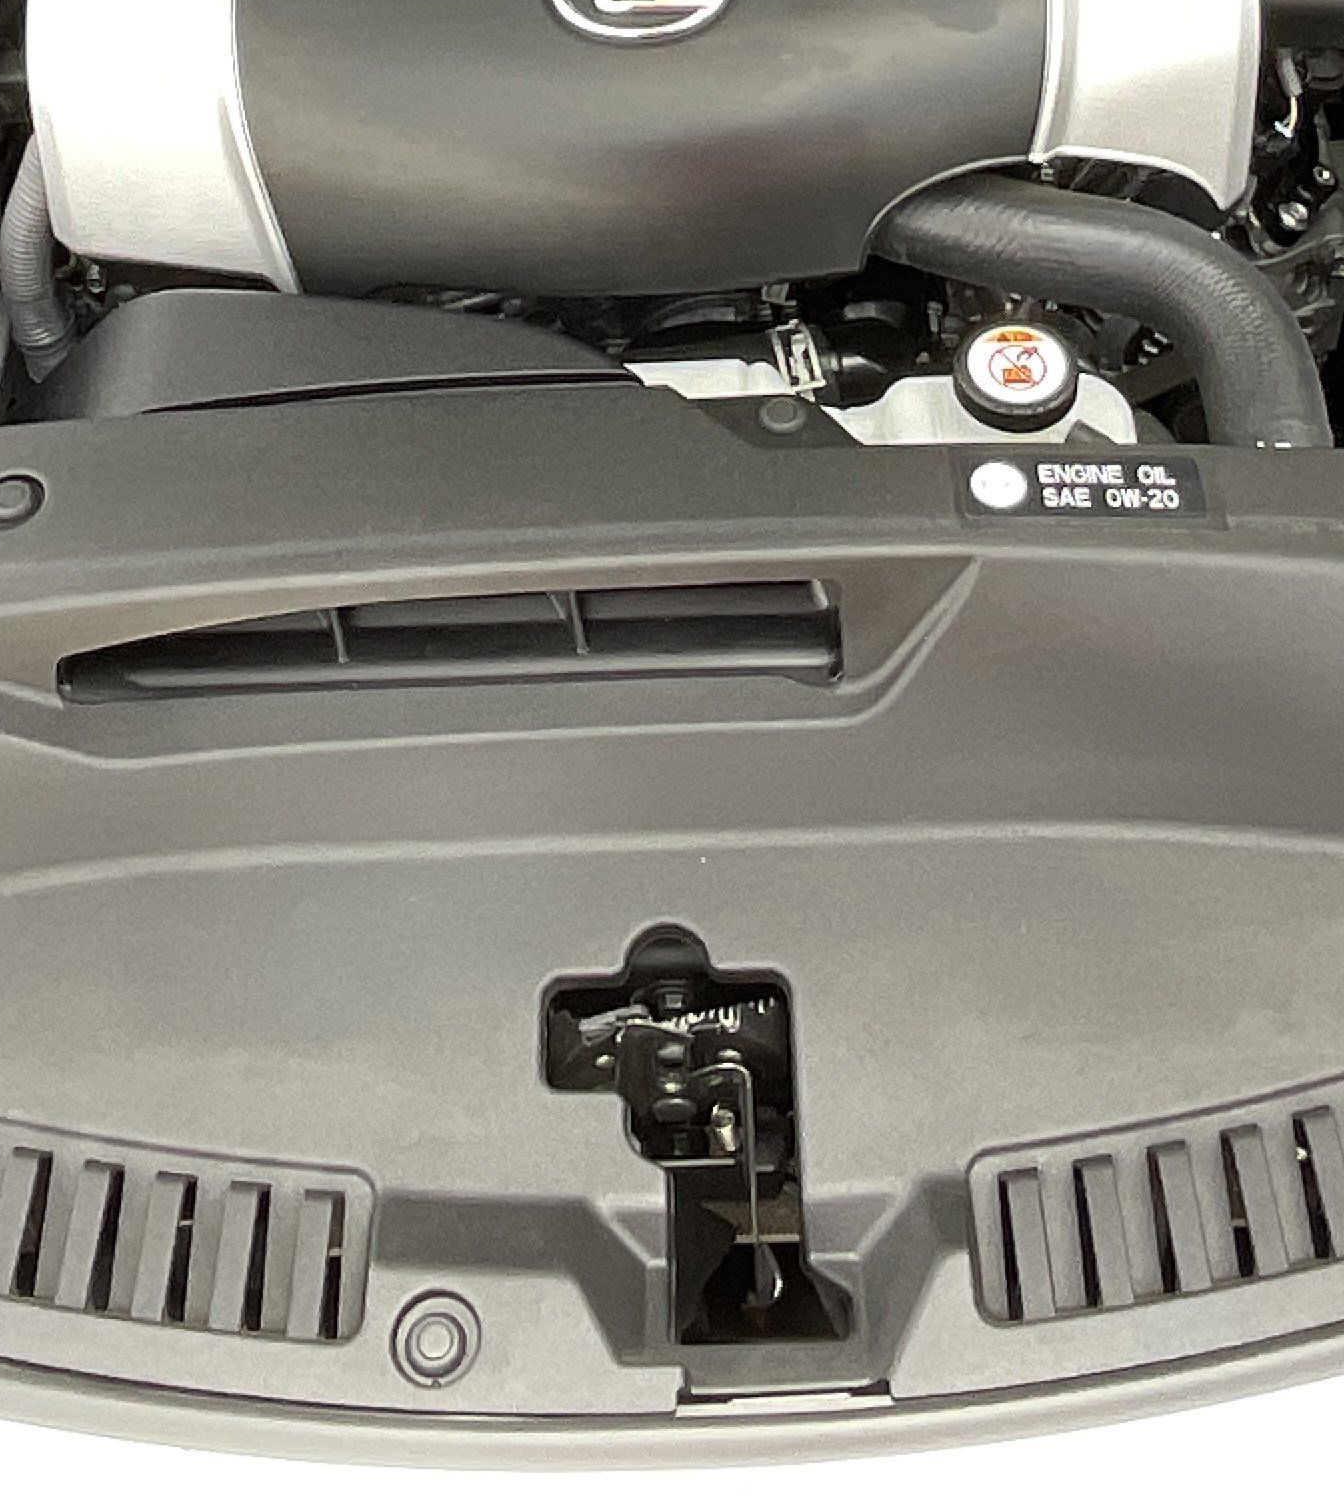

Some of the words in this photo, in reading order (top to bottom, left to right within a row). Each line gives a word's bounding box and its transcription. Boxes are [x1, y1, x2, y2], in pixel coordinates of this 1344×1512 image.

[1037, 463, 1124, 484] ENGINE
[1137, 464, 1176, 486] OIL
[1043, 487, 1092, 508] SAE
[1105, 488, 1180, 509] 0W-20
